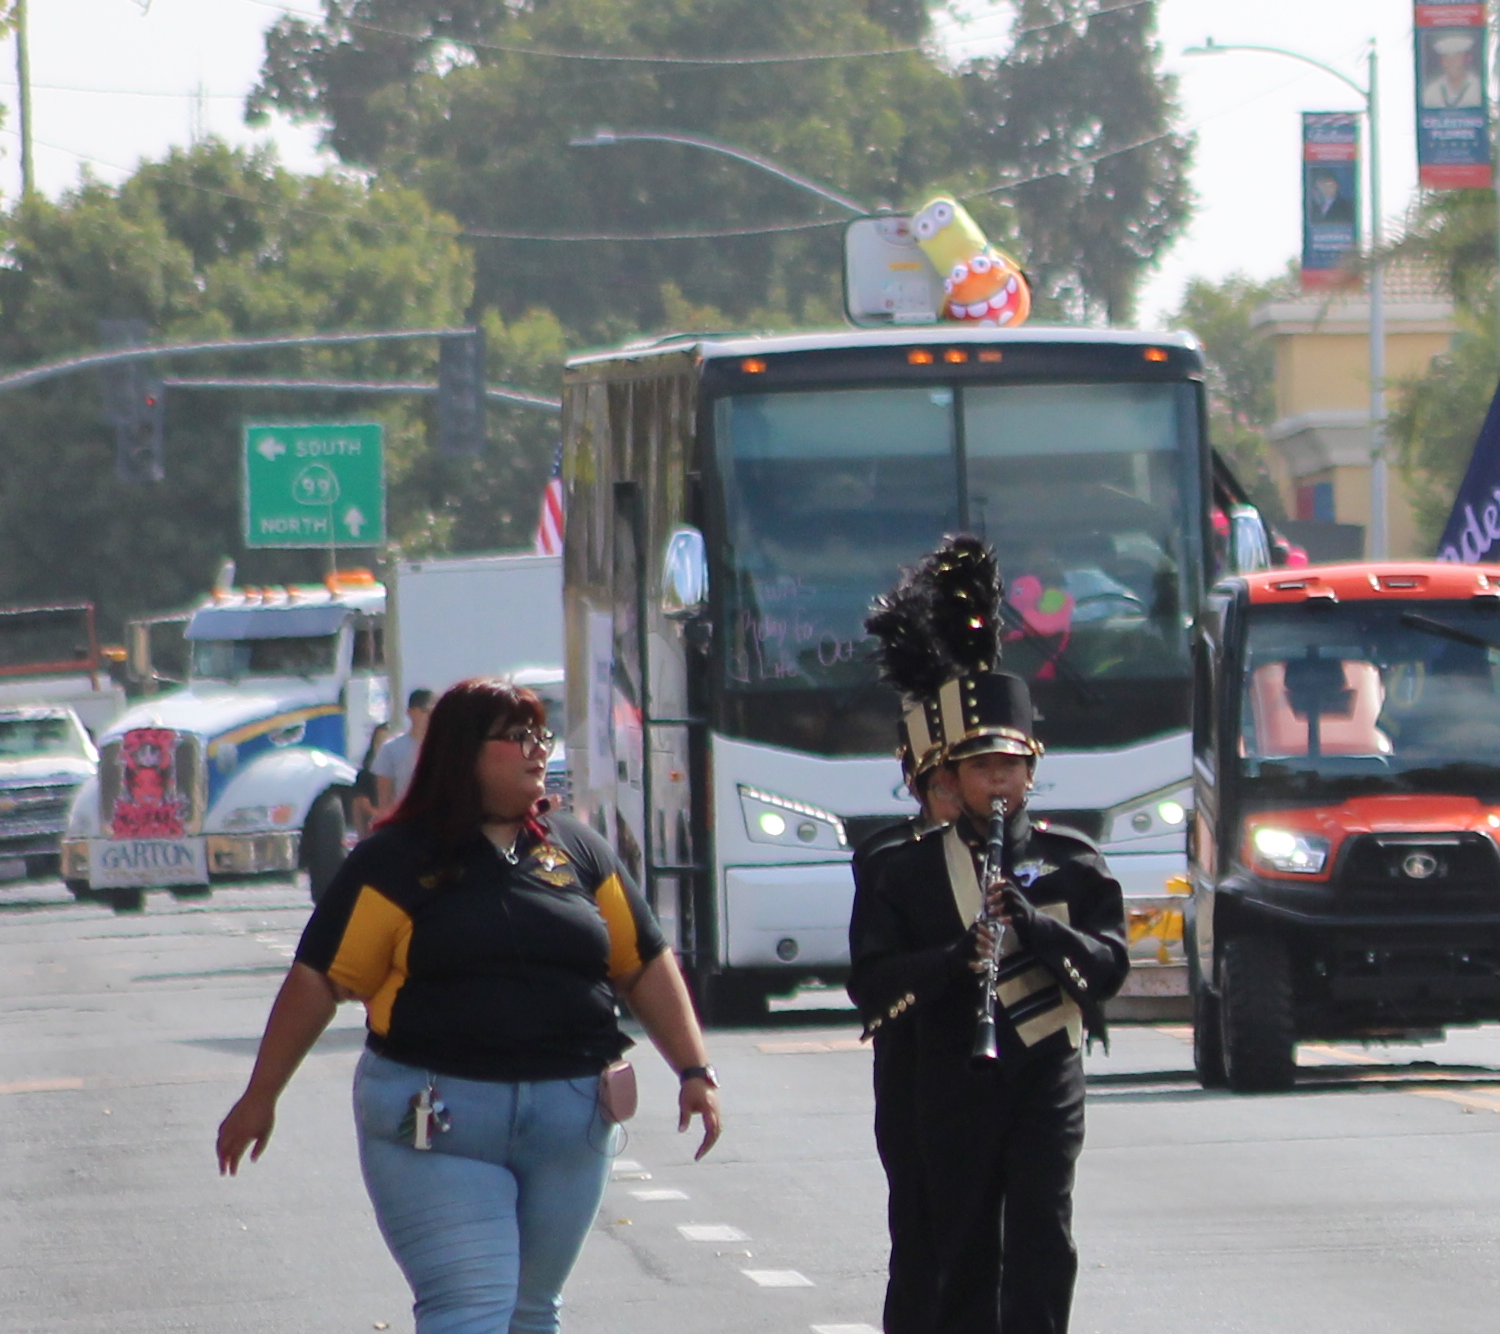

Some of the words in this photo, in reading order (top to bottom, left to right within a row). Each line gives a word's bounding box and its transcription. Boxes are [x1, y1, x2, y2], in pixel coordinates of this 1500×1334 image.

[295, 439, 362, 458] SOUTH
[302, 477, 331, 497] 99
[261, 518, 328, 534] NORTH
[103, 842, 194, 868] GARTON
